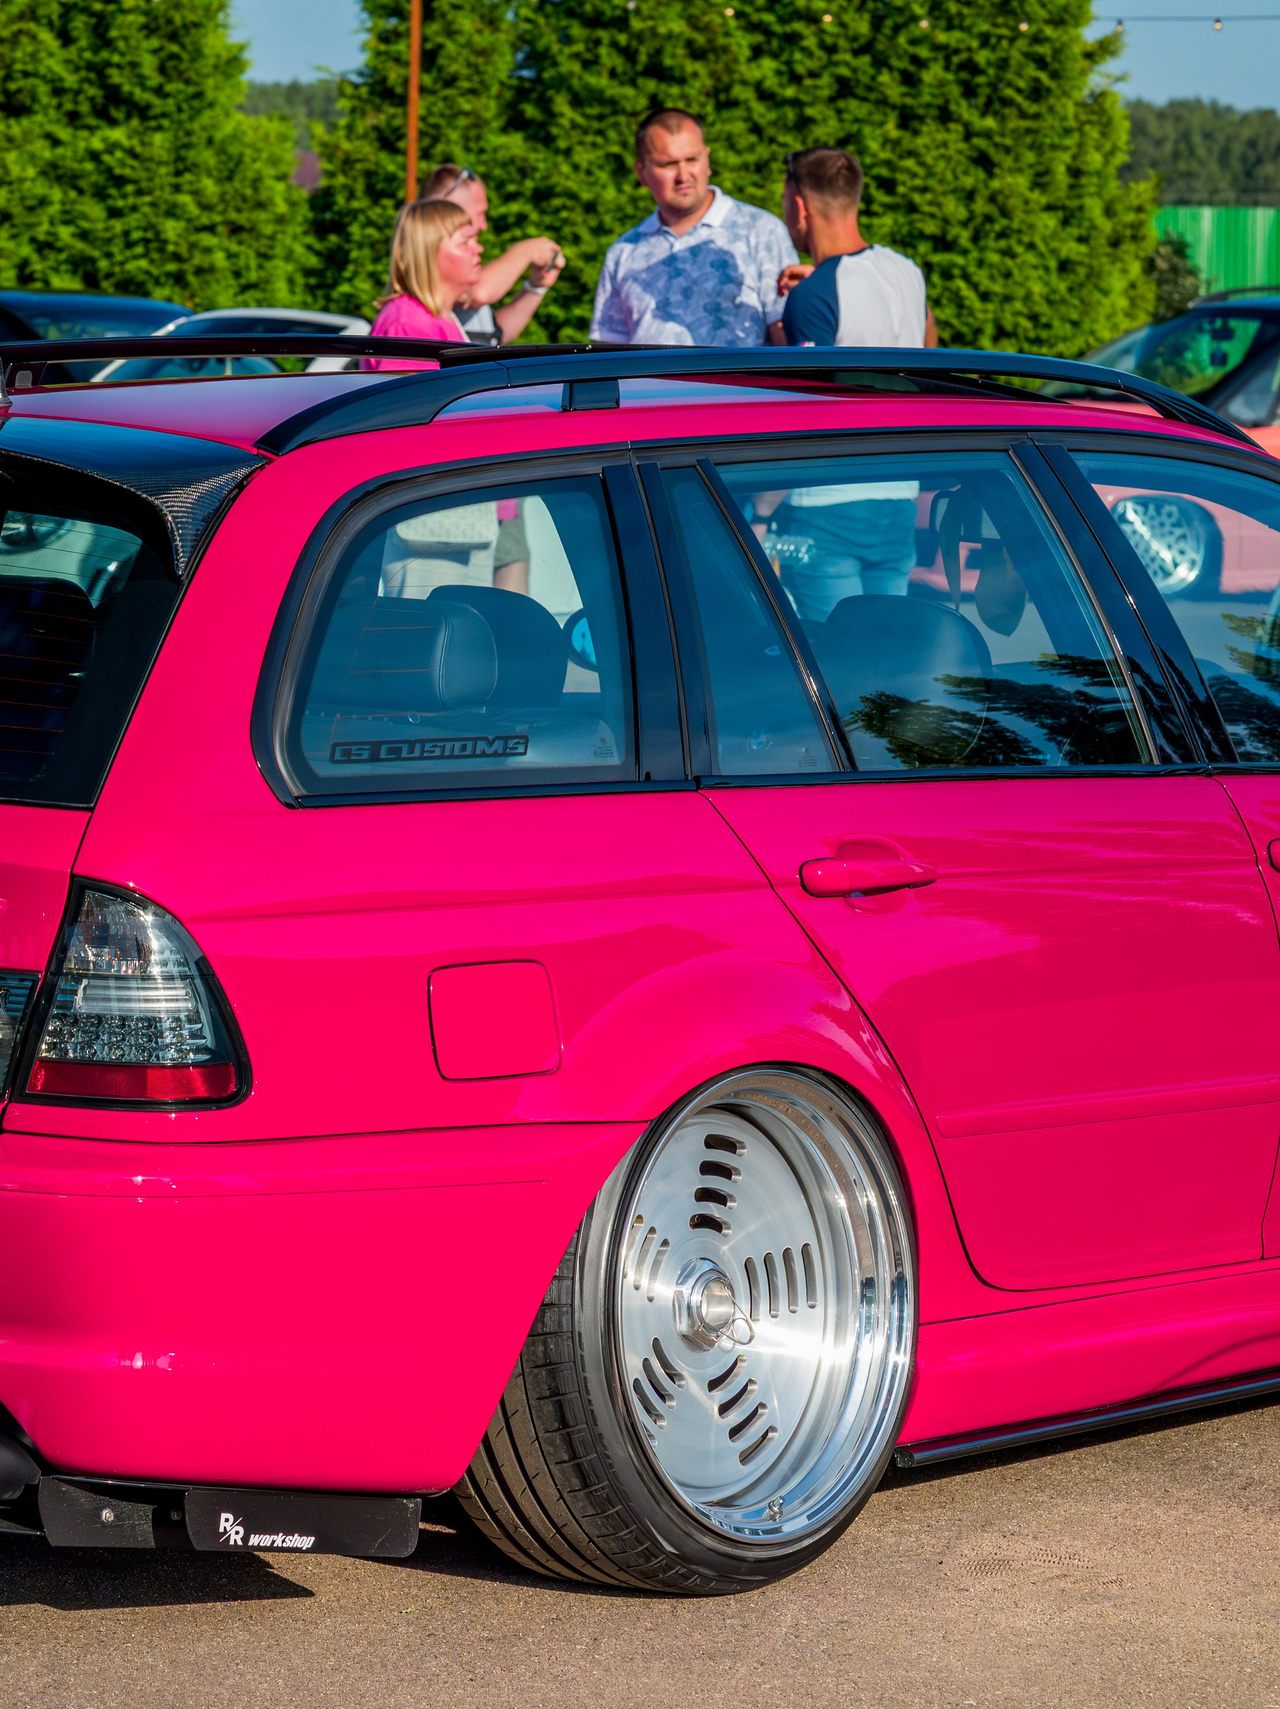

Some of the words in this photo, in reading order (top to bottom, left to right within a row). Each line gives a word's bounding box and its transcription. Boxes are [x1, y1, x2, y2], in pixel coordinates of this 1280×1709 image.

[334, 743, 371, 760] CS
[379, 738, 526, 759] CUSTOMS
[248, 1533, 315, 1550] workshop
